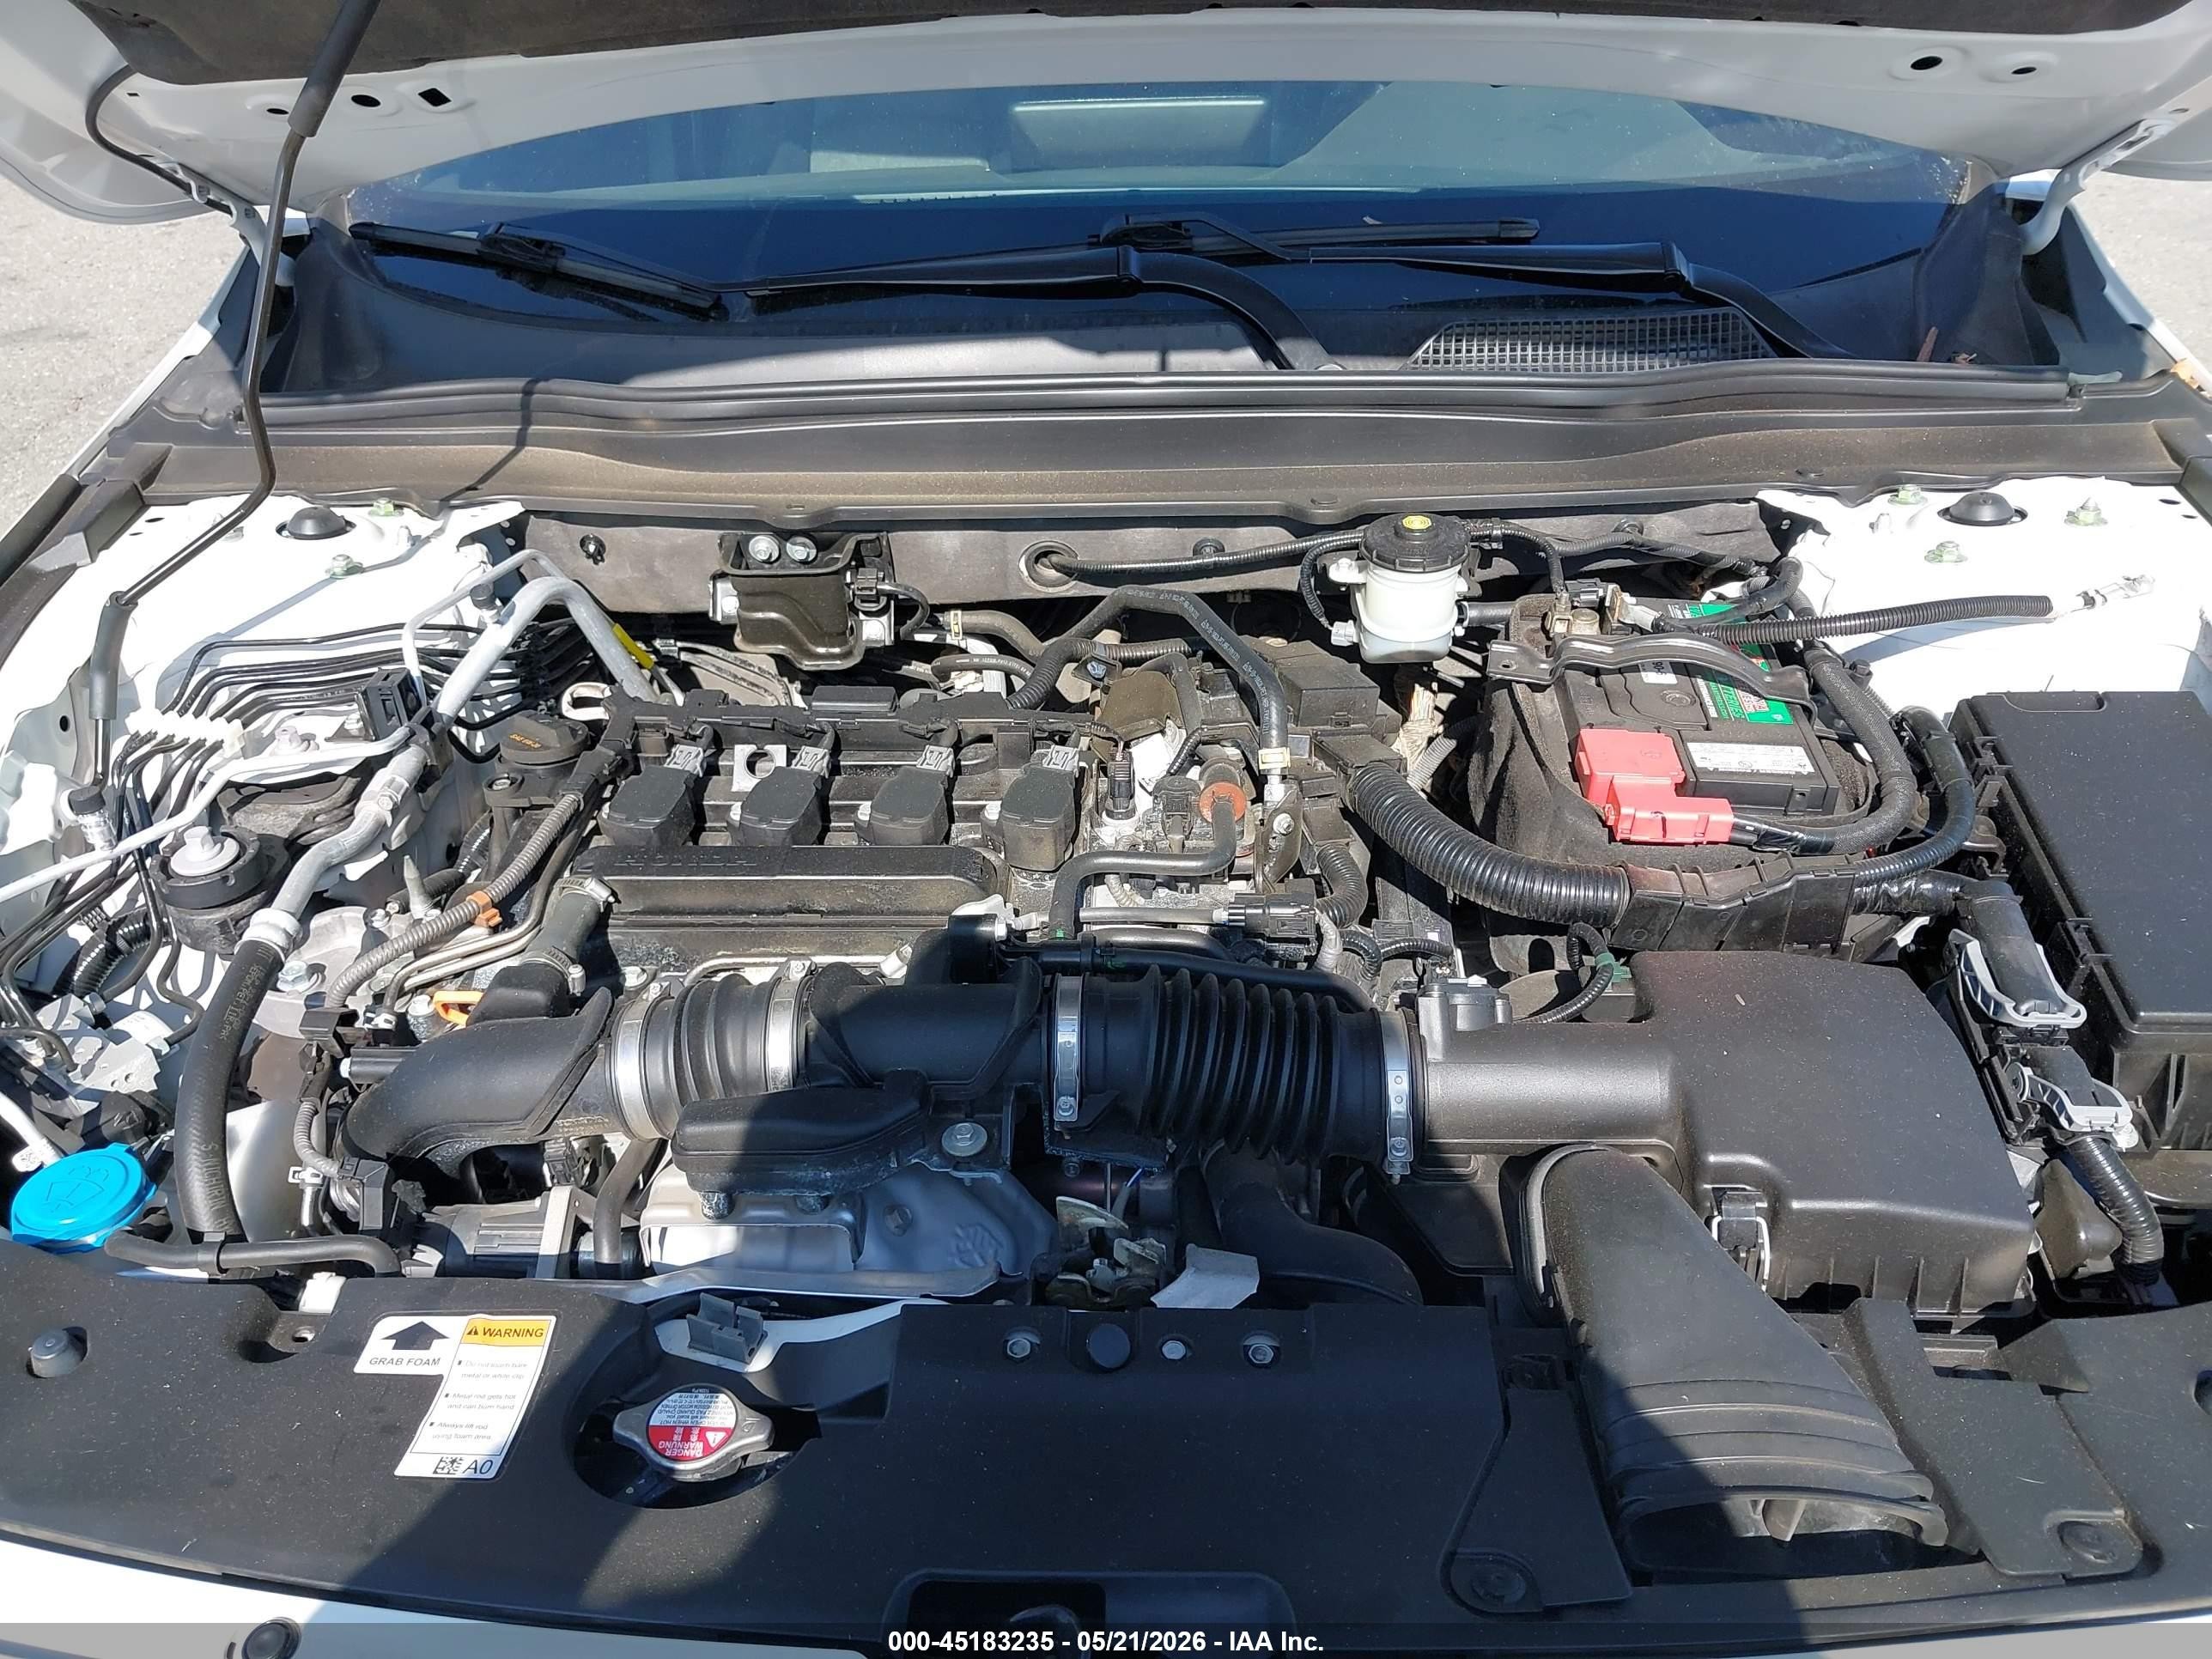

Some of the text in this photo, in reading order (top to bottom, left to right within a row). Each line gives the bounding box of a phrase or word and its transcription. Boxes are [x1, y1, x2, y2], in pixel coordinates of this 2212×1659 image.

[483, 1327, 544, 1338] WARNING
[369, 1358, 441, 1367] GRAB FOAM
[658, 1441, 704, 1449] WARNUNG
[665, 1448, 703, 1457] DANGER
[462, 1460, 494, 1474] A0
